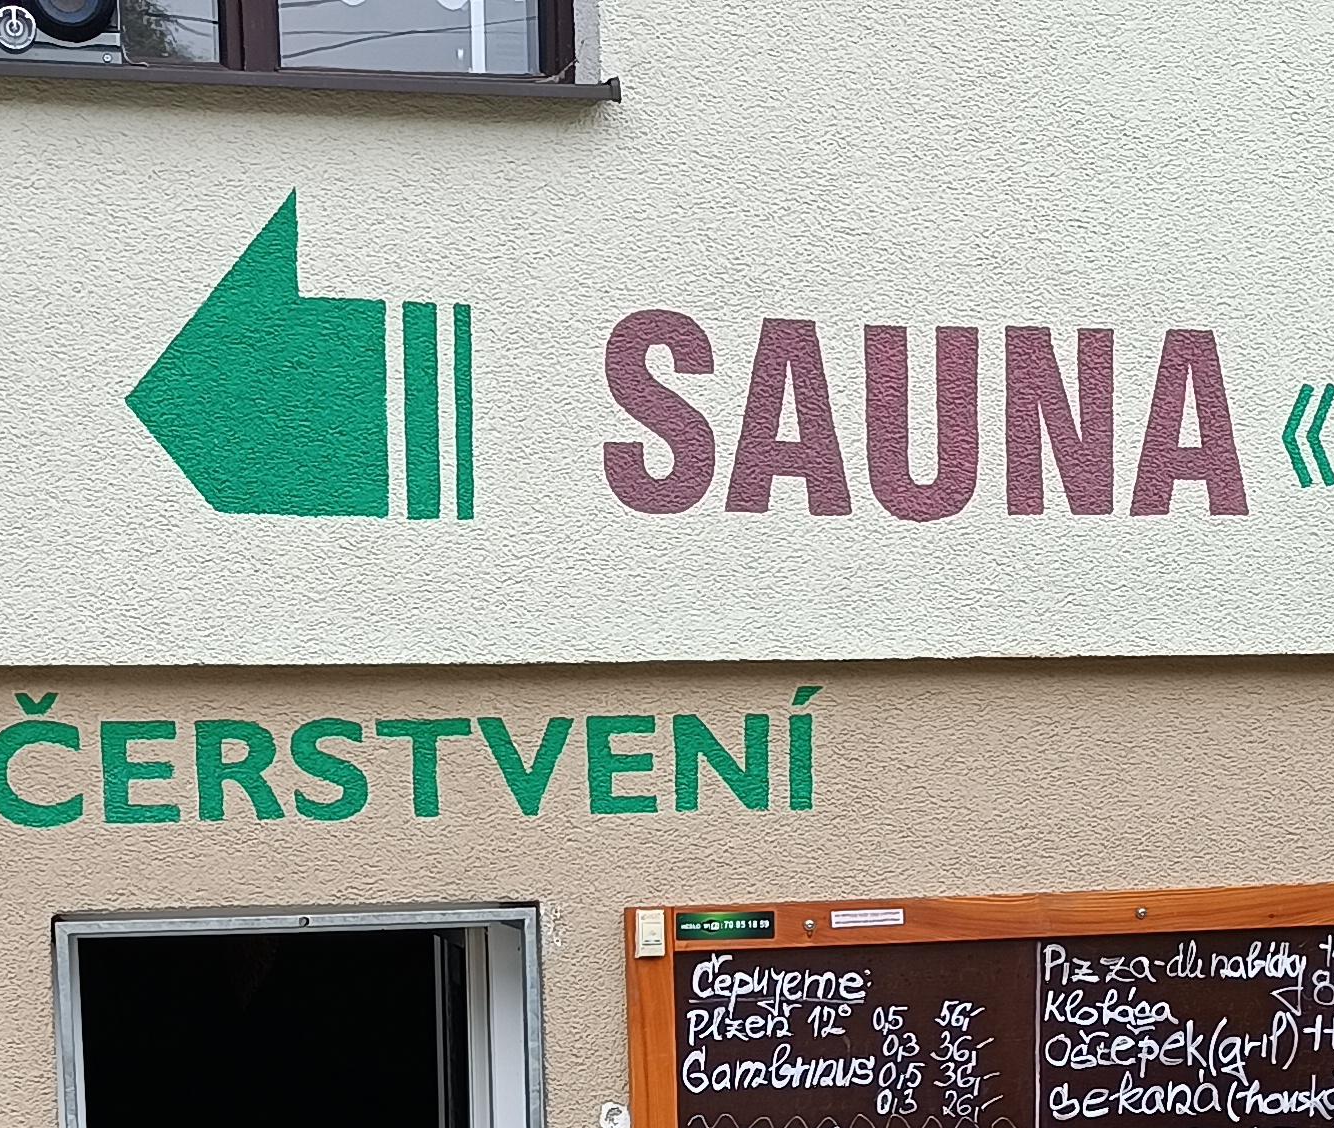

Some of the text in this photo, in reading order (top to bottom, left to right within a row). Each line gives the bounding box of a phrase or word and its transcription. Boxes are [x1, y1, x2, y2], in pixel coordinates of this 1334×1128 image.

[603, 308, 1250, 523] SAUNA
[686, 999, 803, 1046] Plzeň
[873, 1005, 909, 1035] 0,5
[682, 1044, 877, 1094] Gambrinus
[877, 1061, 924, 1091] 0,5
[882, 1031, 921, 1063] 0,3
[876, 1087, 919, 1117] 0,3
